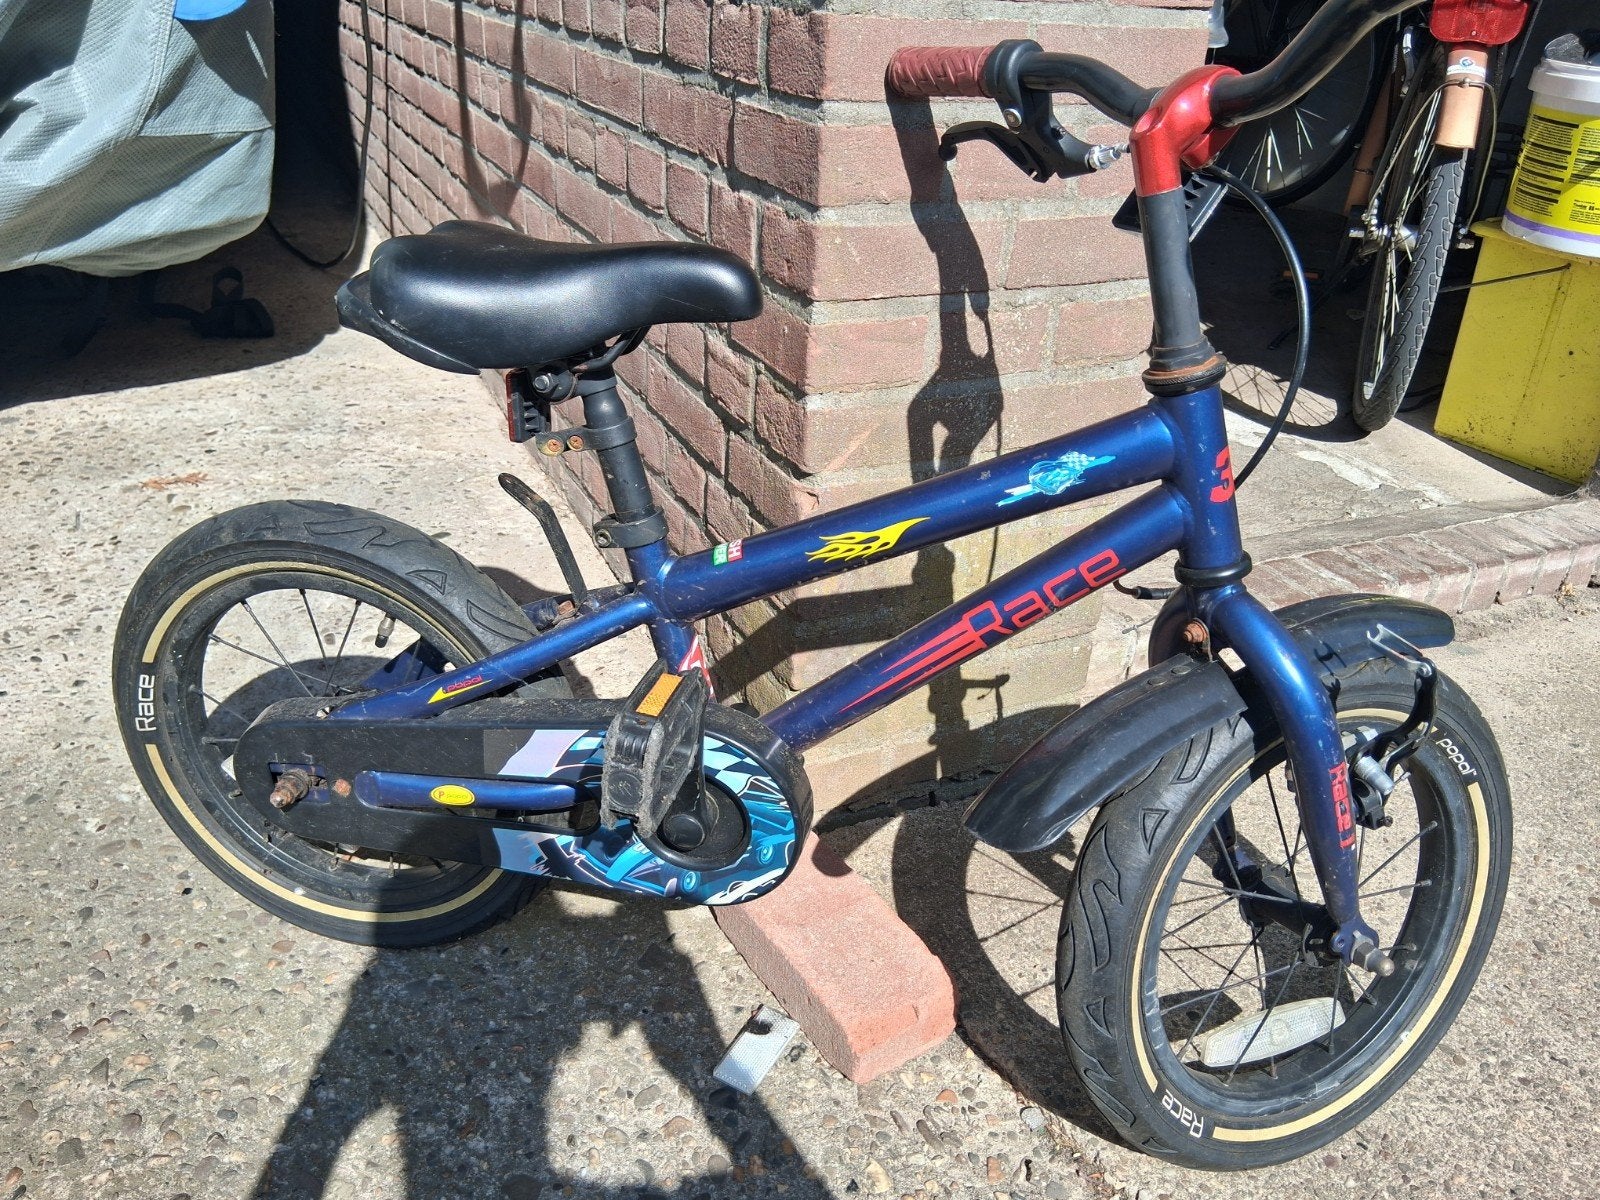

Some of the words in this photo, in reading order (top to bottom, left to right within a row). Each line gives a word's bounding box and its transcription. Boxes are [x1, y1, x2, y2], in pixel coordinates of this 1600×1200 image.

[961, 549, 1127, 648] Race
[135, 674, 157, 732] Race
[1328, 761, 1353, 832] Race
[1161, 1088, 1204, 1138] Race
